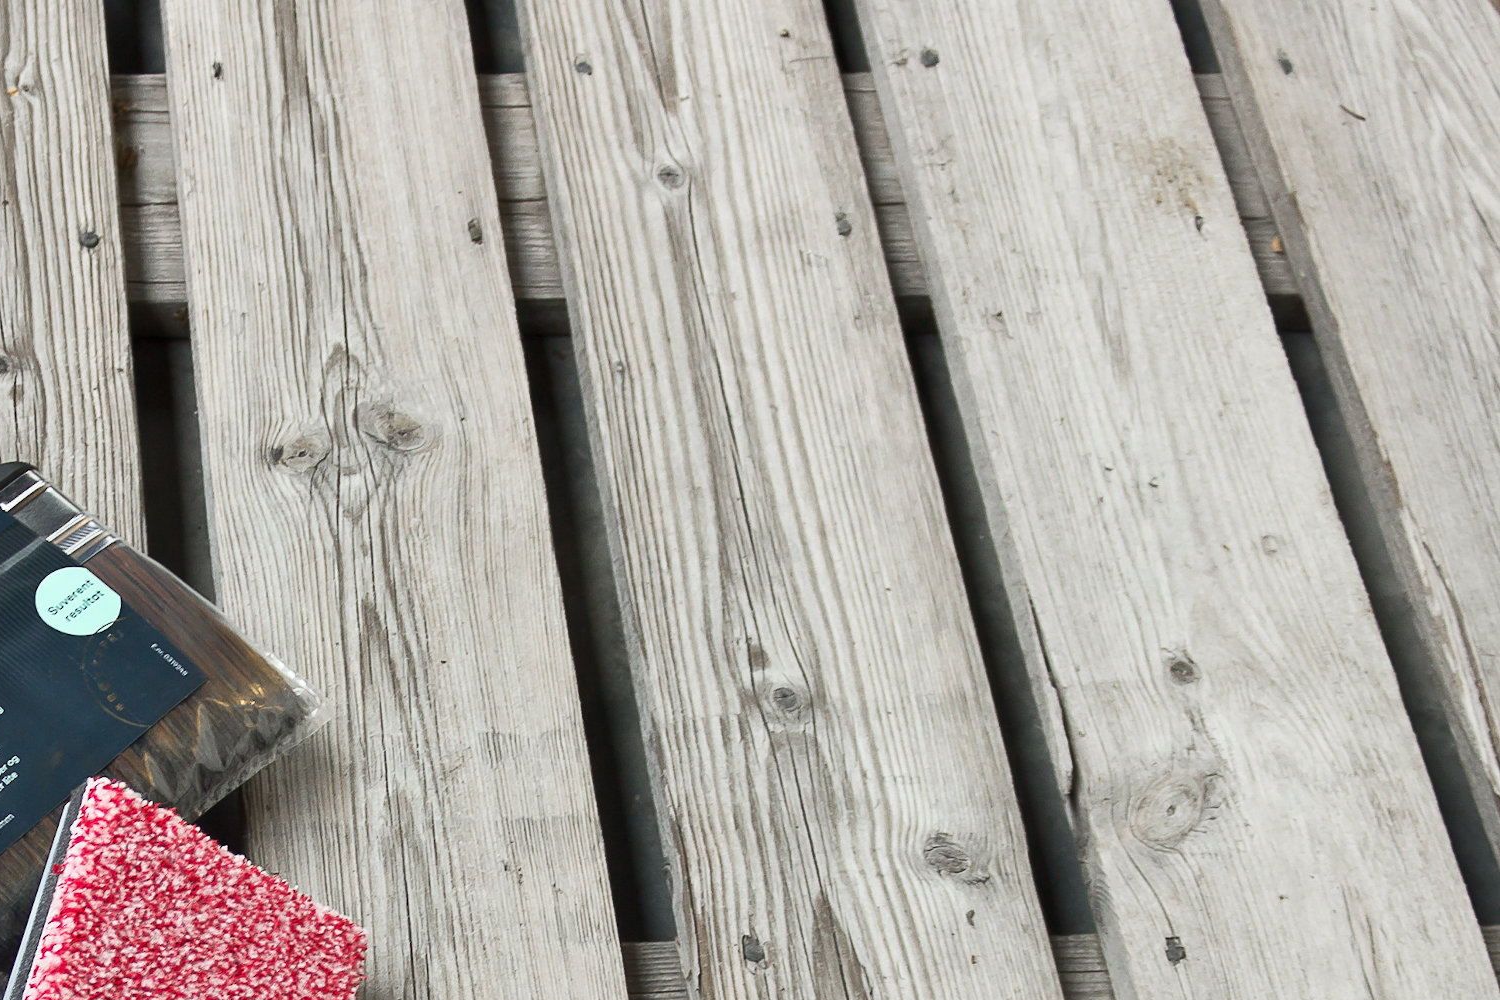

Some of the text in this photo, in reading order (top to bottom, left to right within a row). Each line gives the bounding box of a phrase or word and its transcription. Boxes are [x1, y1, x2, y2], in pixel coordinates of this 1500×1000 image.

[48, 580, 94, 616] Suverent
[65, 590, 105, 622] resultat
[7, 755, 20, 767] og
